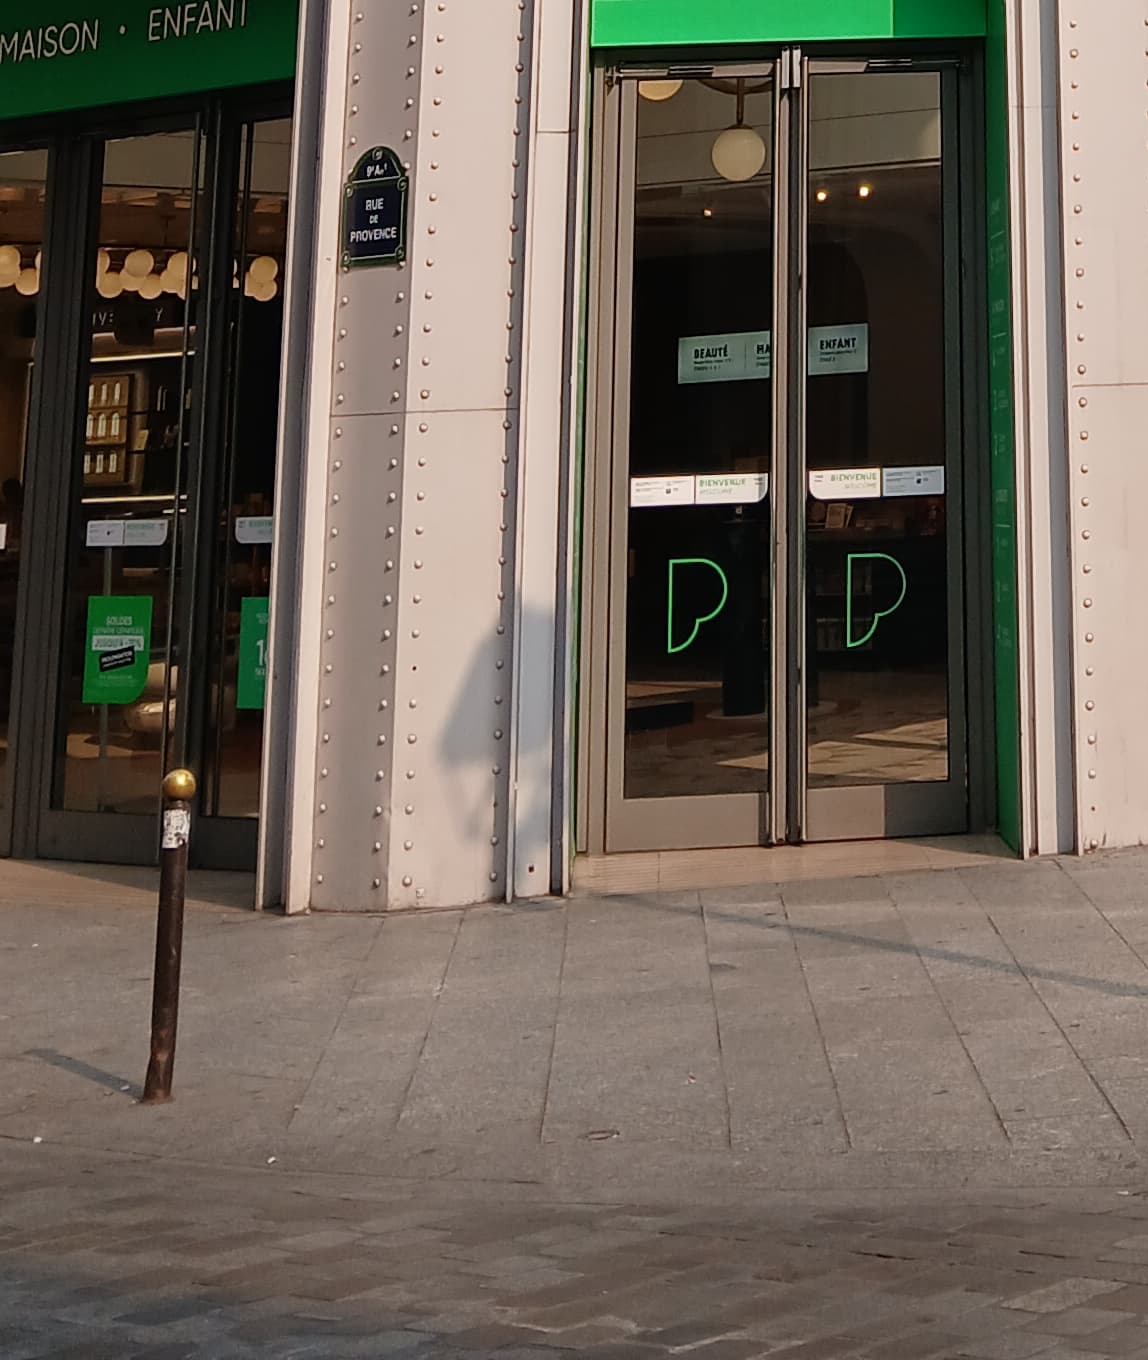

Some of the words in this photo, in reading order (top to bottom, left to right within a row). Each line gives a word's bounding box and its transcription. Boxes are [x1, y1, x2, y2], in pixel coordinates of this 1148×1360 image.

[0, 18, 99, 64] MAISON
[365, 197, 384, 211] RUE
[369, 214, 379, 224] DE
[349, 226, 398, 243] PROVENCE
[694, 343, 729, 359] BEAUTÉ
[820, 337, 857, 350] ENFANT
